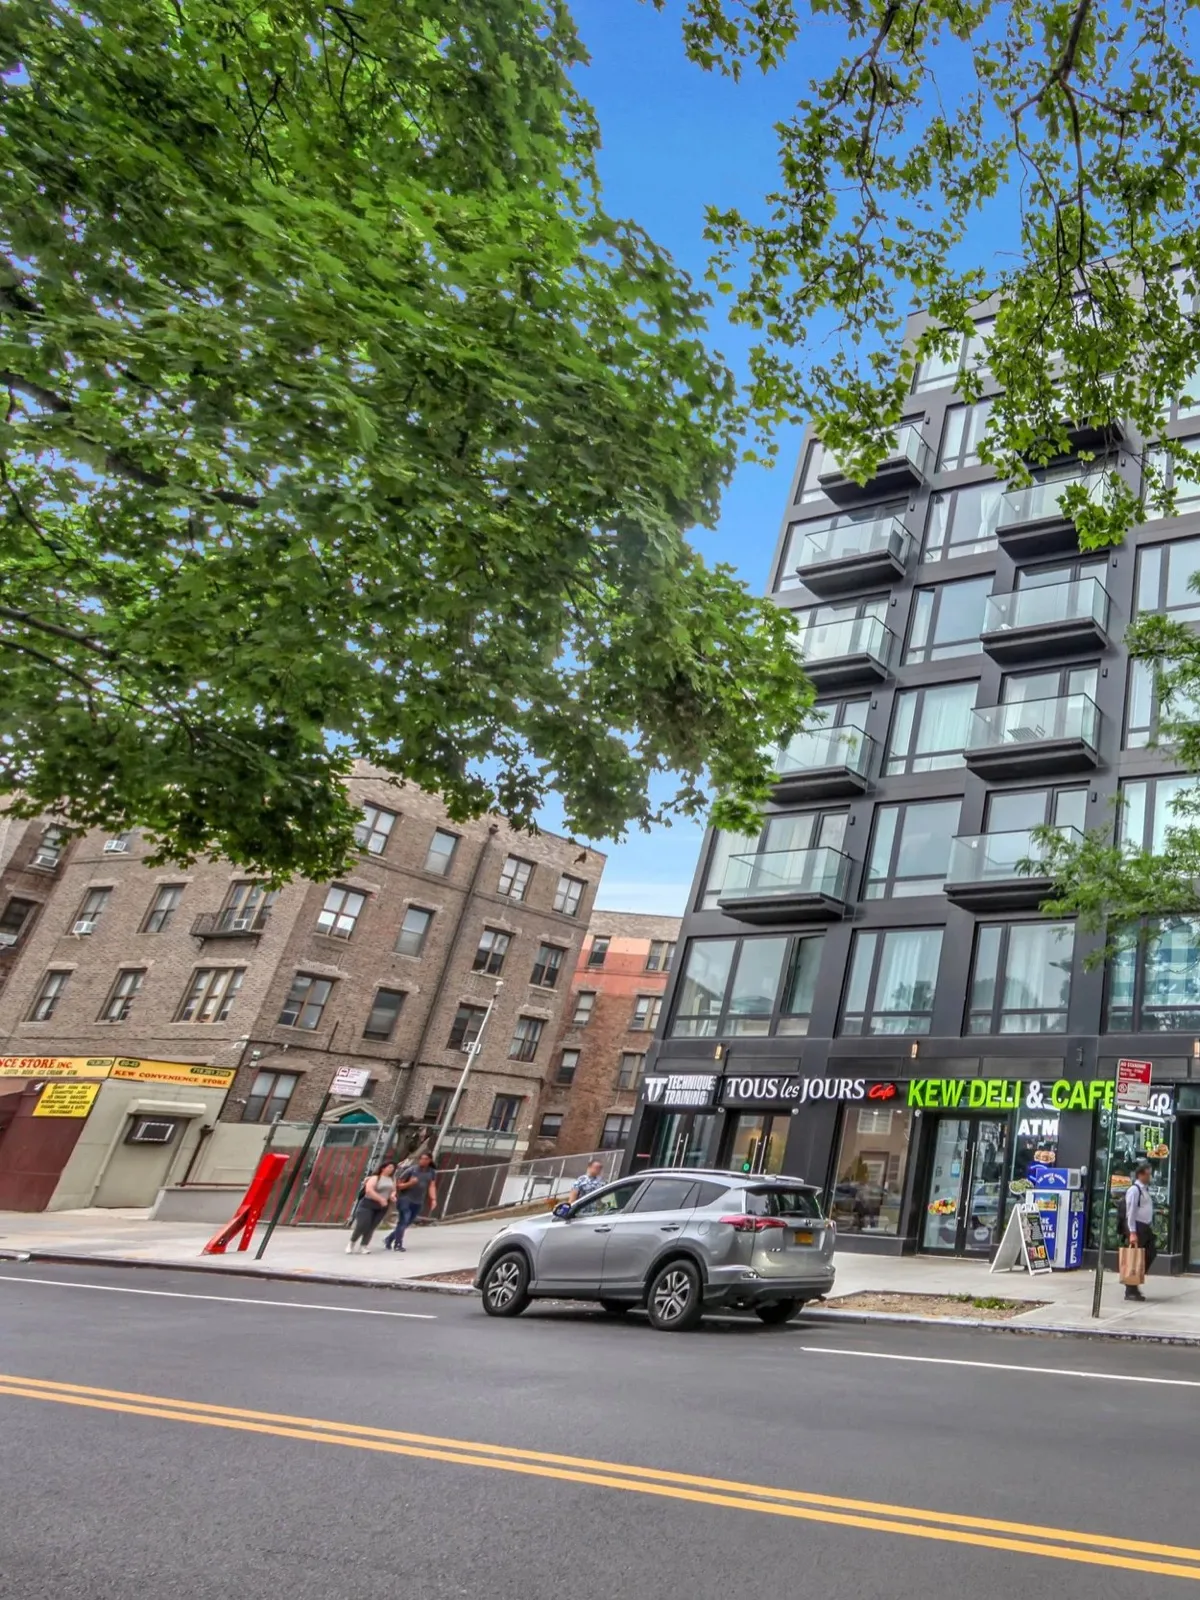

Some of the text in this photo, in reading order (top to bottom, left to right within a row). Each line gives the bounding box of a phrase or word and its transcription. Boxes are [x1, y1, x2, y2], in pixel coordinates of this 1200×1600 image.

[19, 1058, 57, 1069] STORE
[114, 1069, 228, 1085] KEW CONVENIENCE STORE
[667, 1074, 716, 1090] TECHNIQUE
[663, 1089, 709, 1105] TRAINING
[727, 1077, 778, 1098] TOUS
[780, 1077, 800, 1098] les
[800, 1078, 866, 1104] JOURS
[908, 1079, 965, 1108] KEW
[969, 1079, 1021, 1108] DELI
[1026, 1080, 1044, 1110] &
[1051, 1079, 1116, 1110] CAFE
[1018, 1119, 1059, 1136] ATM
